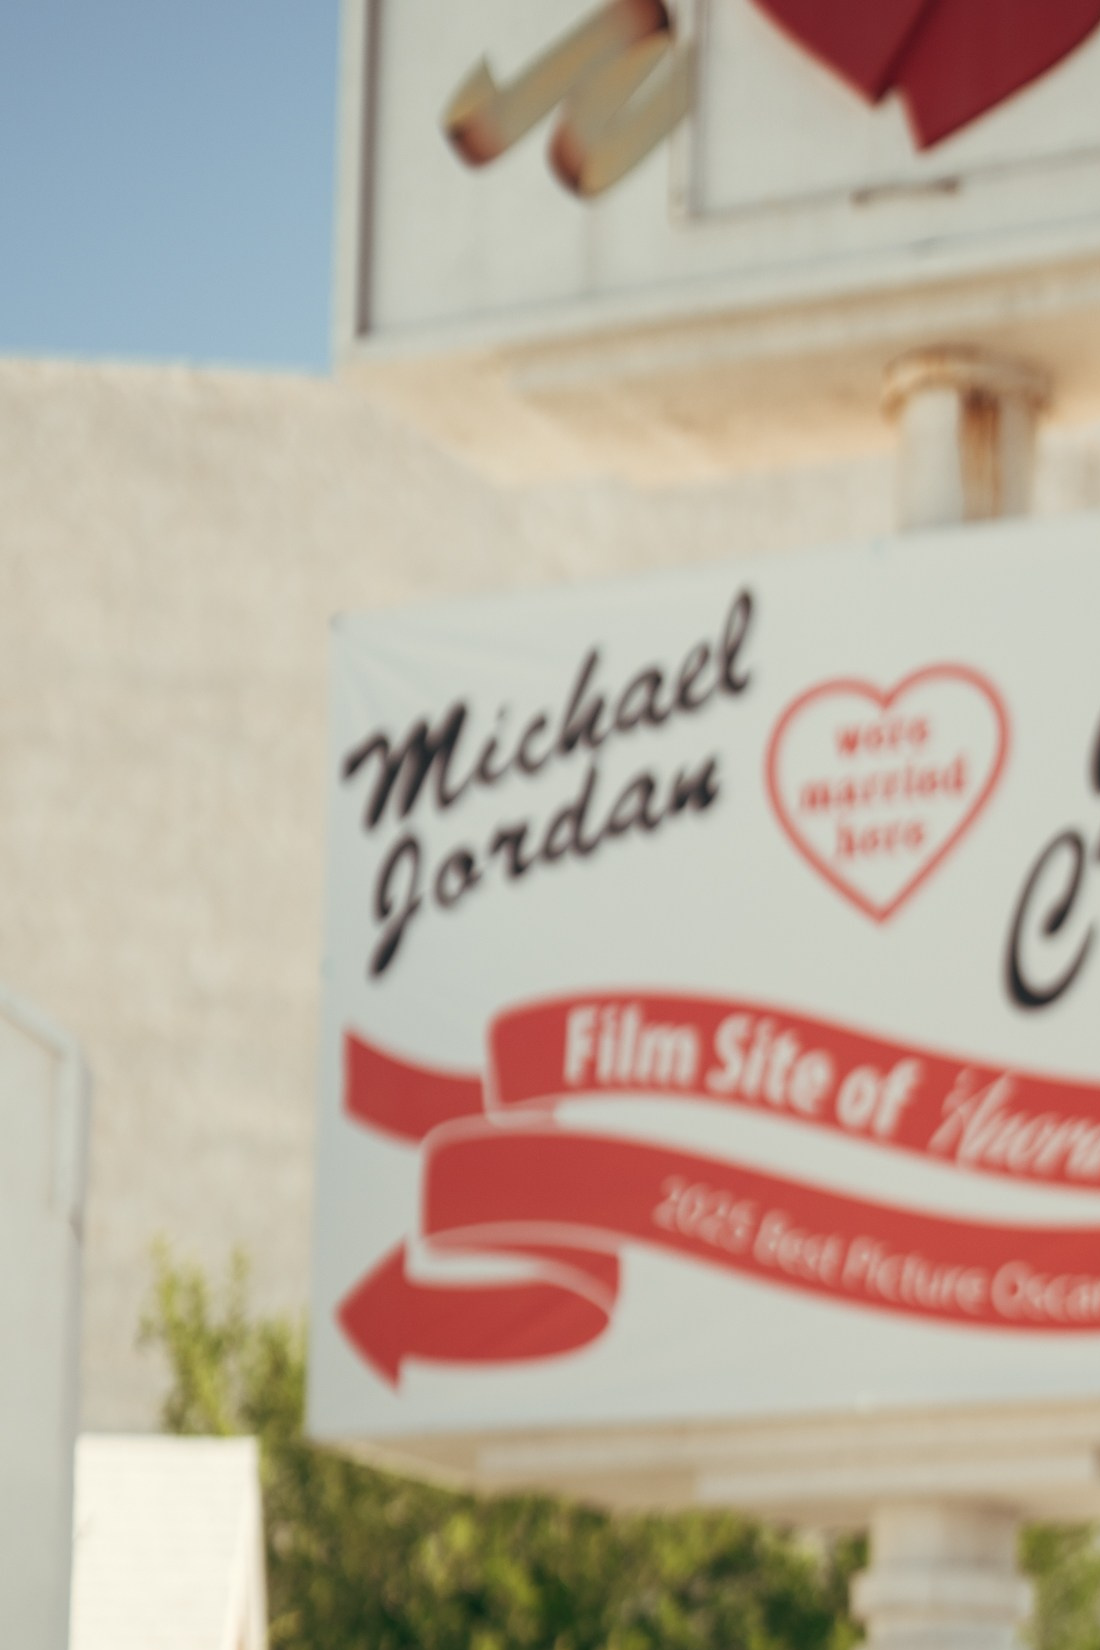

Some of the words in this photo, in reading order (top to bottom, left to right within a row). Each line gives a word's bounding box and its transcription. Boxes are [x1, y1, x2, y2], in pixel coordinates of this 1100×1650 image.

[342, 583, 755, 832] Michael
[799, 751, 967, 814] married
[368, 755, 720, 982] Jordan
[564, 1000, 699, 1087] Film
[705, 1011, 836, 1115] Site
[836, 1057, 923, 1140] of
[652, 1173, 761, 1254] 2025
[752, 1208, 847, 1290] Best
[843, 1232, 991, 1315] Picture
